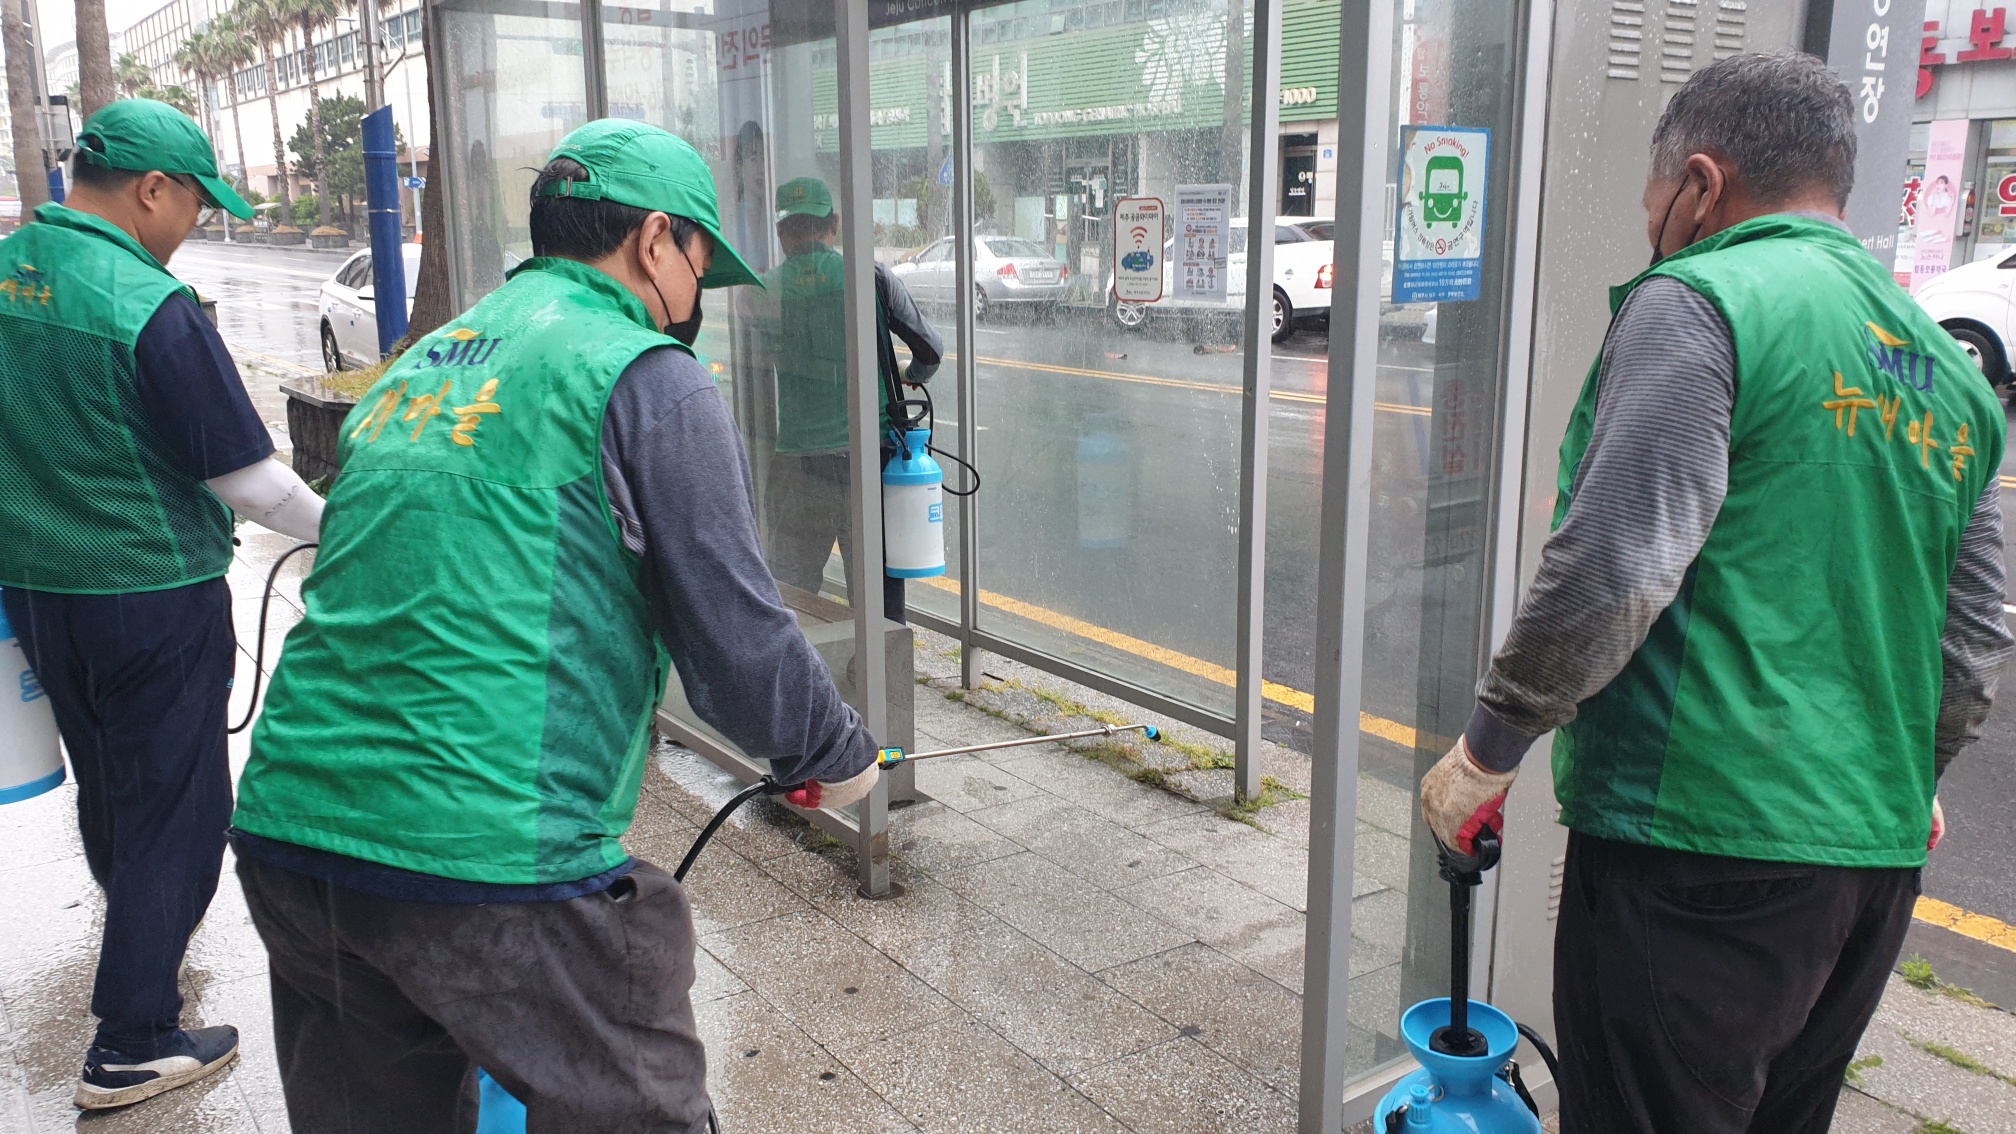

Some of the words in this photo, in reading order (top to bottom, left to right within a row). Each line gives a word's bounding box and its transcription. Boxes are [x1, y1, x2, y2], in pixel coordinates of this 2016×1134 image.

[972, 51, 1028, 131] 병원
[1424, 142, 1436, 155] No
[1436, 136, 1470, 159] Smoking!
[1876, 234, 1895, 249] Hall
[415, 337, 503, 370] SMU
[1863, 325, 1936, 394] SMU
[350, 378, 502, 447] 새마을
